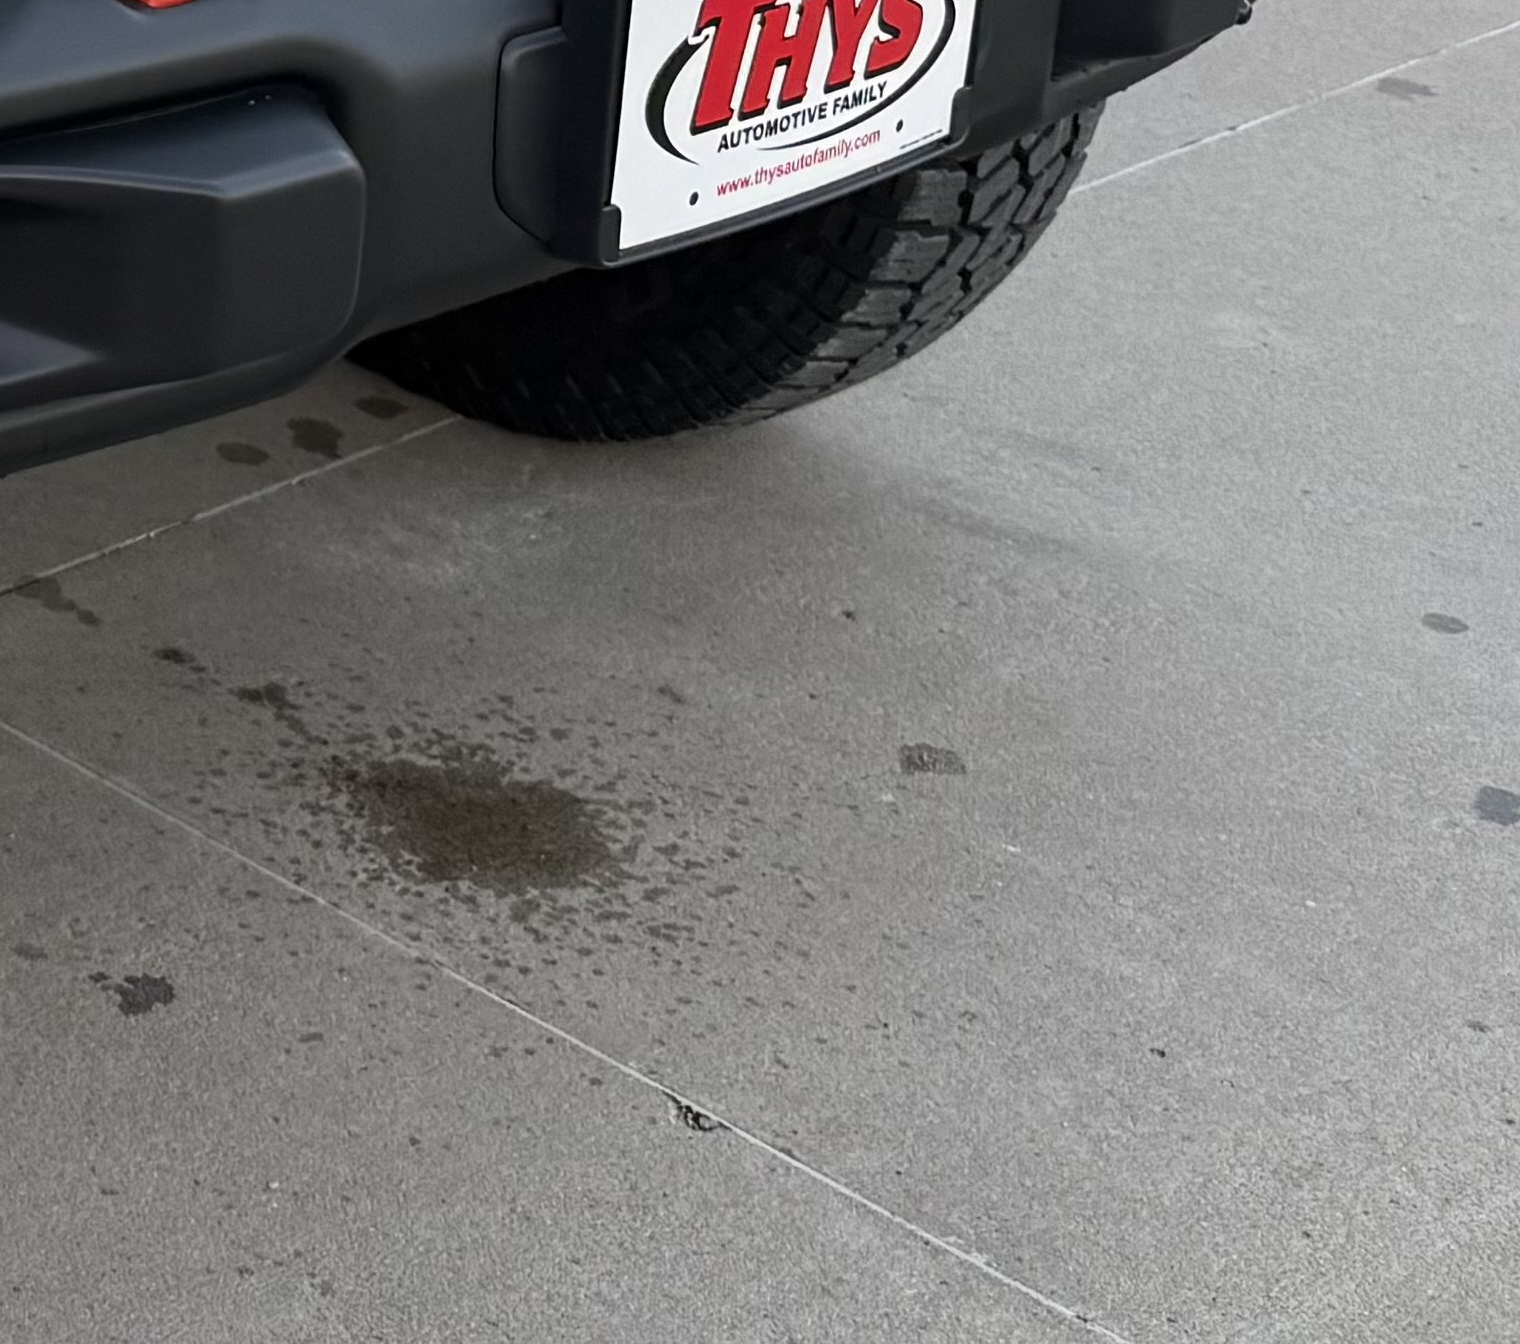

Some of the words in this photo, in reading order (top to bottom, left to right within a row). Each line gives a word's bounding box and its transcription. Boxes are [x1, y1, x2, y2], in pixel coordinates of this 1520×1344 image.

[717, 101, 829, 153] AUTOMOTIVE
[832, 81, 888, 116] FAMILY
[716, 127, 881, 197] www.thysautofamily.com
